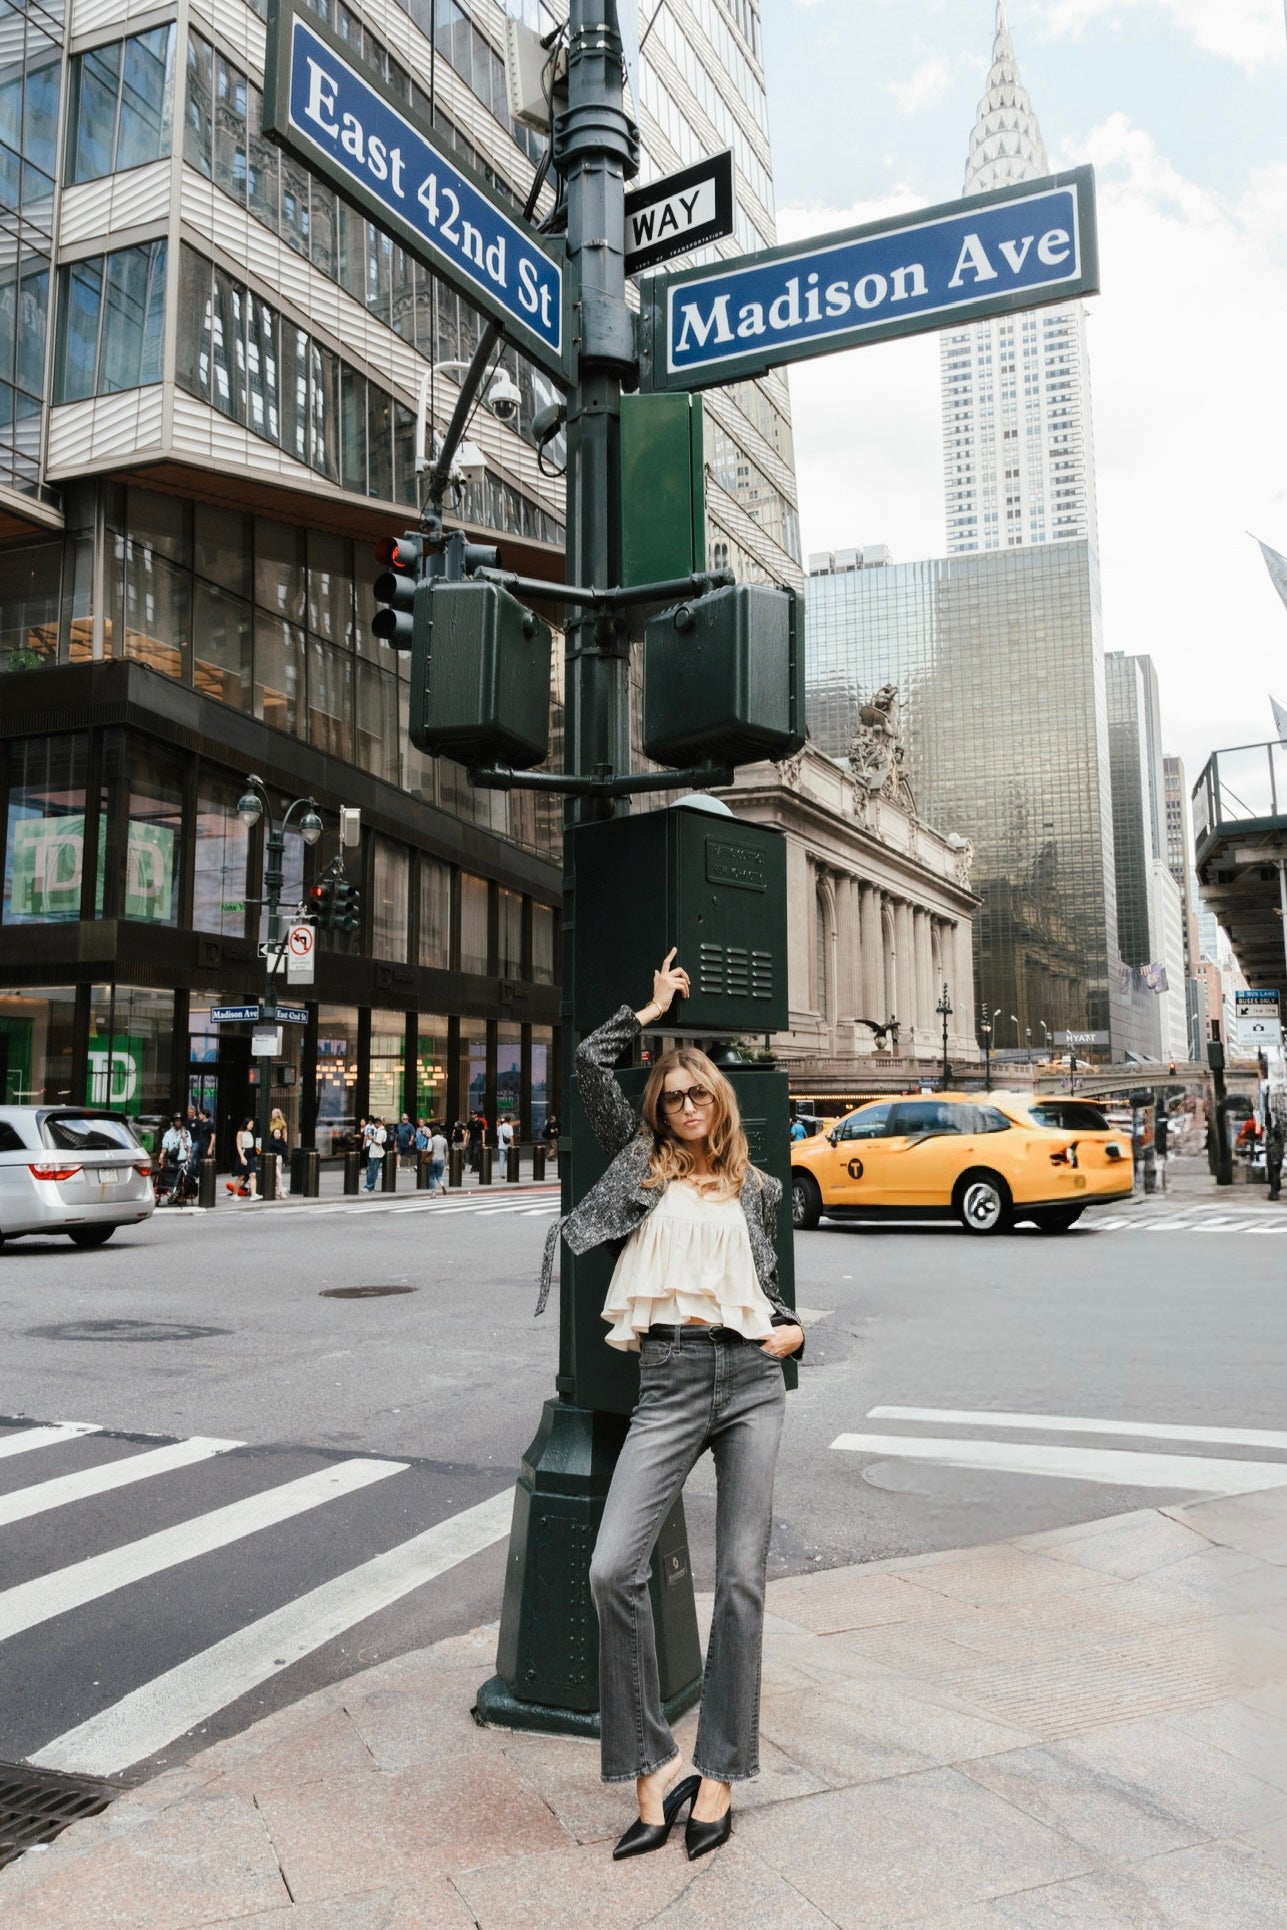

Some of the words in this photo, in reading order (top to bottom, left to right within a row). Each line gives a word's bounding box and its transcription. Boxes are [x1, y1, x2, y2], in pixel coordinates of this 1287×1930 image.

[303, 57, 405, 199] East
[417, 174, 506, 289] 42nd
[518, 257, 552, 329] St
[633, 190, 701, 247] WAY
[670, 231, 724, 256] TRANSPORTATION
[675, 262, 928, 352] Madison
[948, 229, 1071, 289] Ave
[213, 1010, 243, 1019] Madison
[244, 1009, 258, 1018] Ave
[277, 1009, 288, 1019] East
[289, 1011, 300, 1020] 42nd
[301, 1013, 307, 1021] St
[1066, 1034, 1096, 1042] HYATT
[88, 1051, 137, 1103] TD
